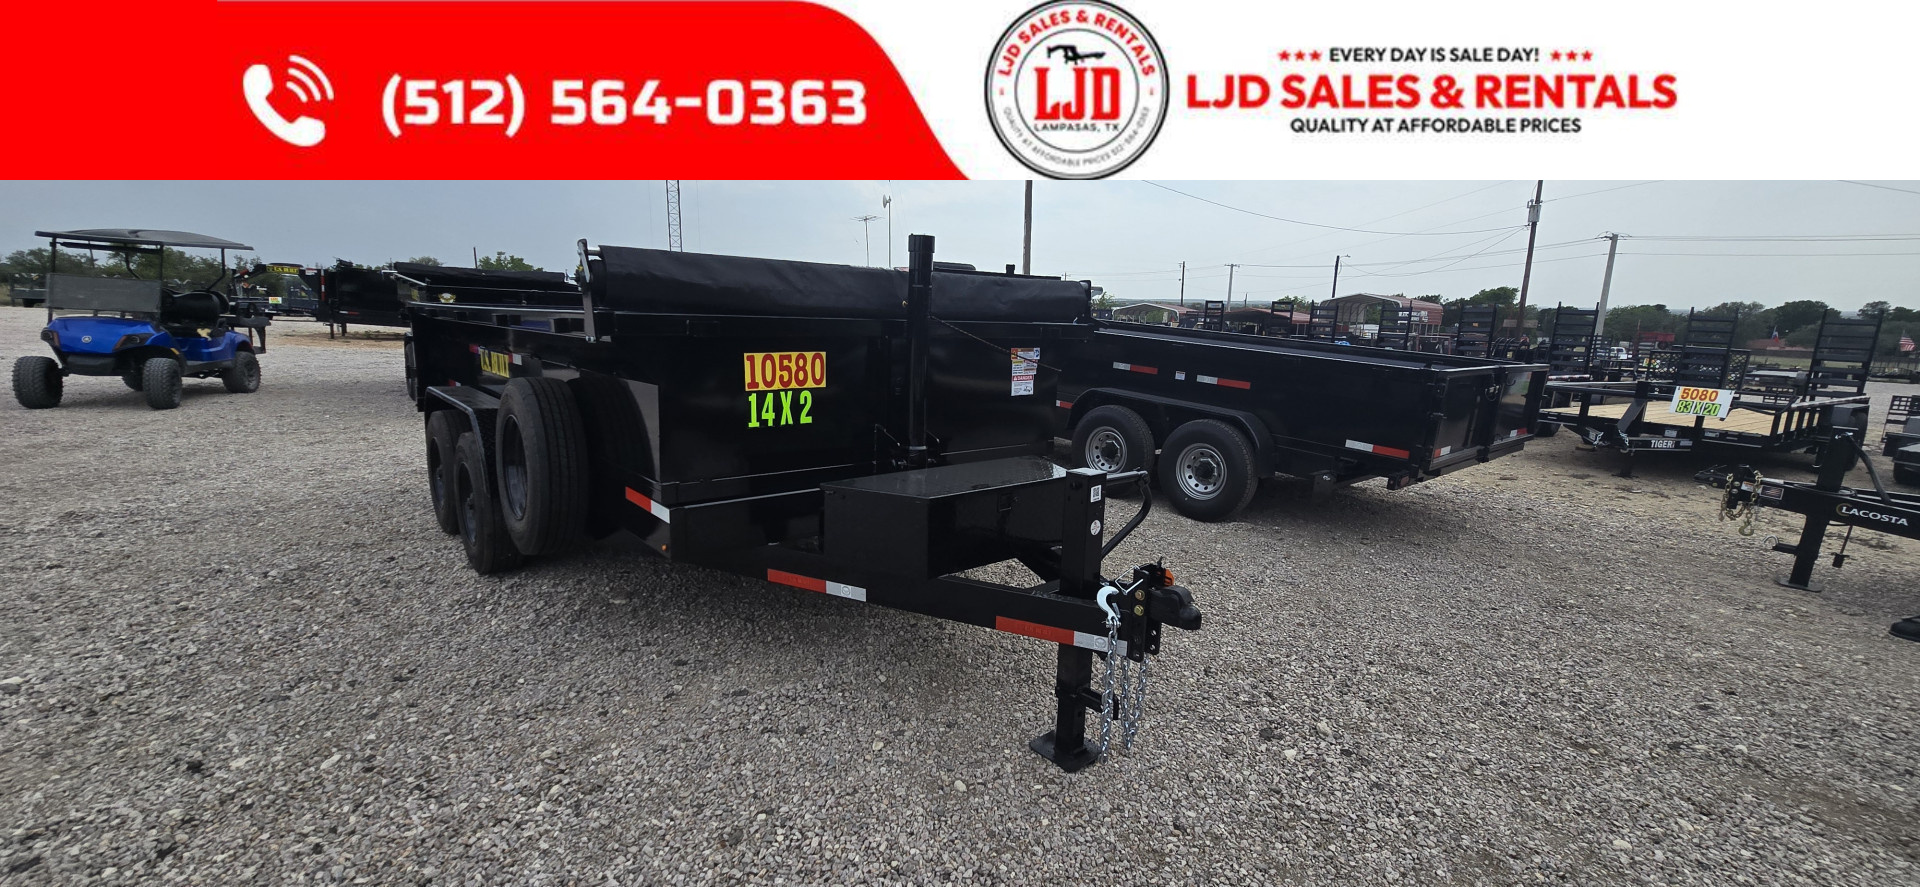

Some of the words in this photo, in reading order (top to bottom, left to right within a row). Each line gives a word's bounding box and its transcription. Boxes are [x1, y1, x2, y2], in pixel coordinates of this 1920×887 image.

[746, 353, 824, 389] 10580
[1681, 388, 1719, 402] 5080
[748, 393, 775, 428] 14
[780, 390, 793, 425] X
[800, 390, 812, 424] 2
[1676, 401, 1693, 413] 83
[1693, 402, 1703, 414] X
[1703, 403, 1721, 416] 20
[1651, 440, 1673, 448] TIGER
[1841, 506, 1909, 526] LACOSTA
